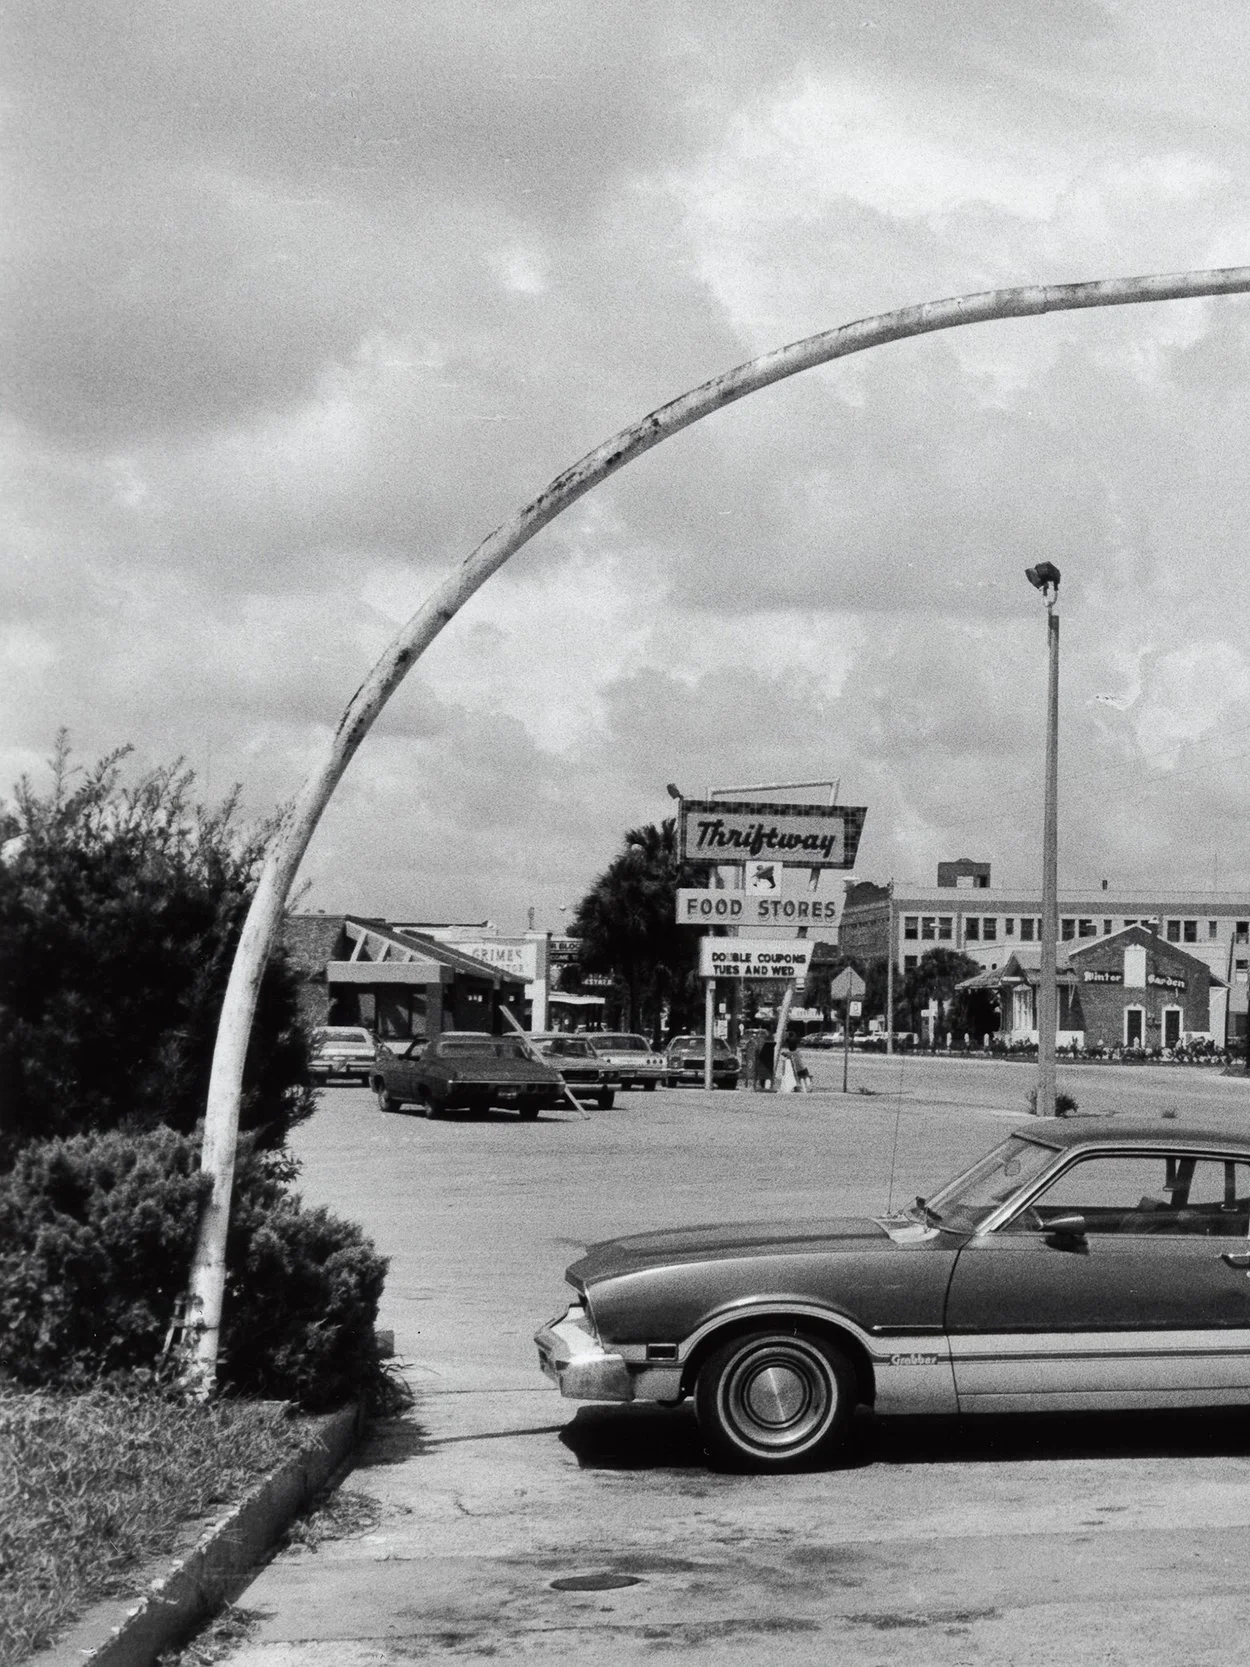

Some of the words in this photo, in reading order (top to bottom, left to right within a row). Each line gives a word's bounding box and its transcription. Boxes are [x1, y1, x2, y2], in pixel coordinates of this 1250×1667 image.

[697, 819, 836, 858] Thriftway
[686, 898, 743, 917] FOOD
[757, 899, 836, 919] STORES
[757, 953, 806, 964] COUPONS
[713, 965, 740, 975] TUES
[744, 965, 768, 976] AND
[771, 965, 795, 976] WED
[1083, 971, 1122, 982] Winter
[1147, 974, 1185, 988] Garden
